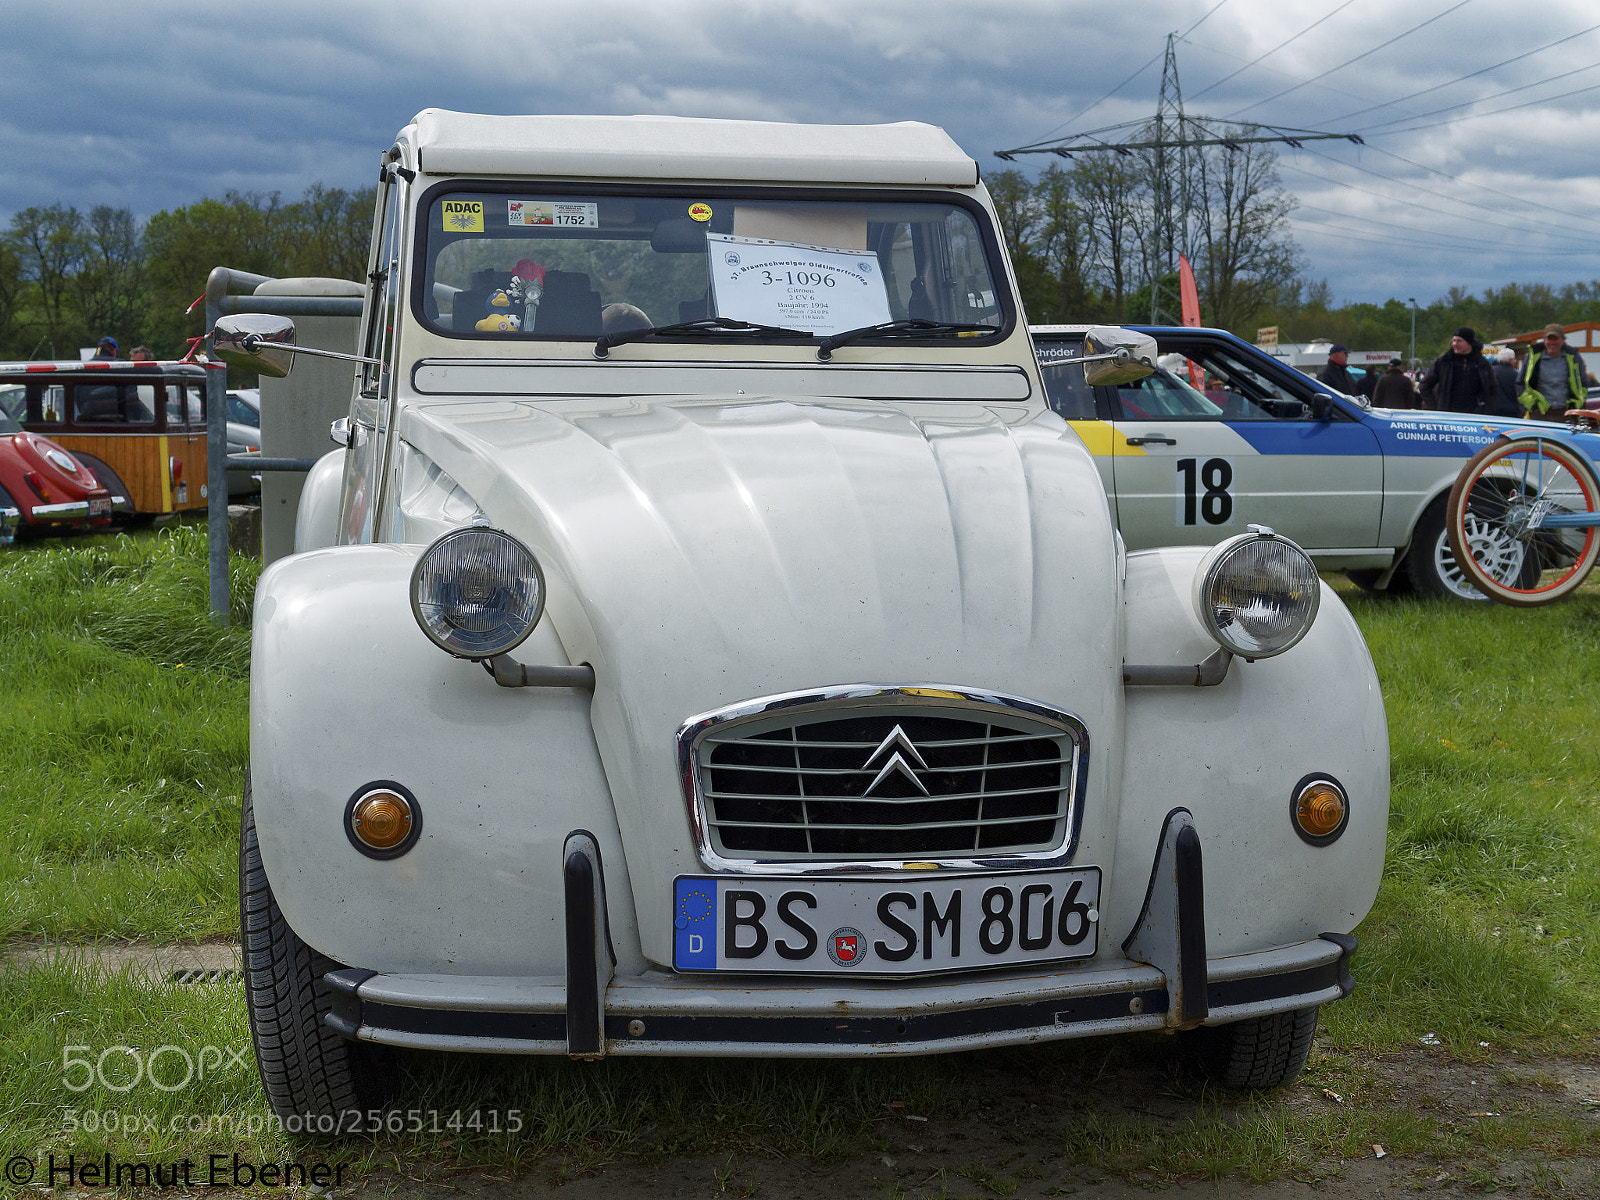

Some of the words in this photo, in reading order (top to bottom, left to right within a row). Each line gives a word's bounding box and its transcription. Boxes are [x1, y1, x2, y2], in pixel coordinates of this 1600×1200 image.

[445, 203, 481, 213] ADAC
[556, 215, 585, 225] 1752
[761, 270, 836, 288] 3-1096
[1035, 348, 1075, 357] chröder
[1419, 424, 1478, 432] PETTERSON
[1396, 432, 1437, 442] GUNNAR
[1438, 434, 1495, 444] PETTERSON
[1176, 457, 1233, 526] 18
[723, 890, 818, 960] BS
[874, 890, 961, 962] SM
[978, 881, 1091, 955] 806
[688, 934, 703, 954] D
